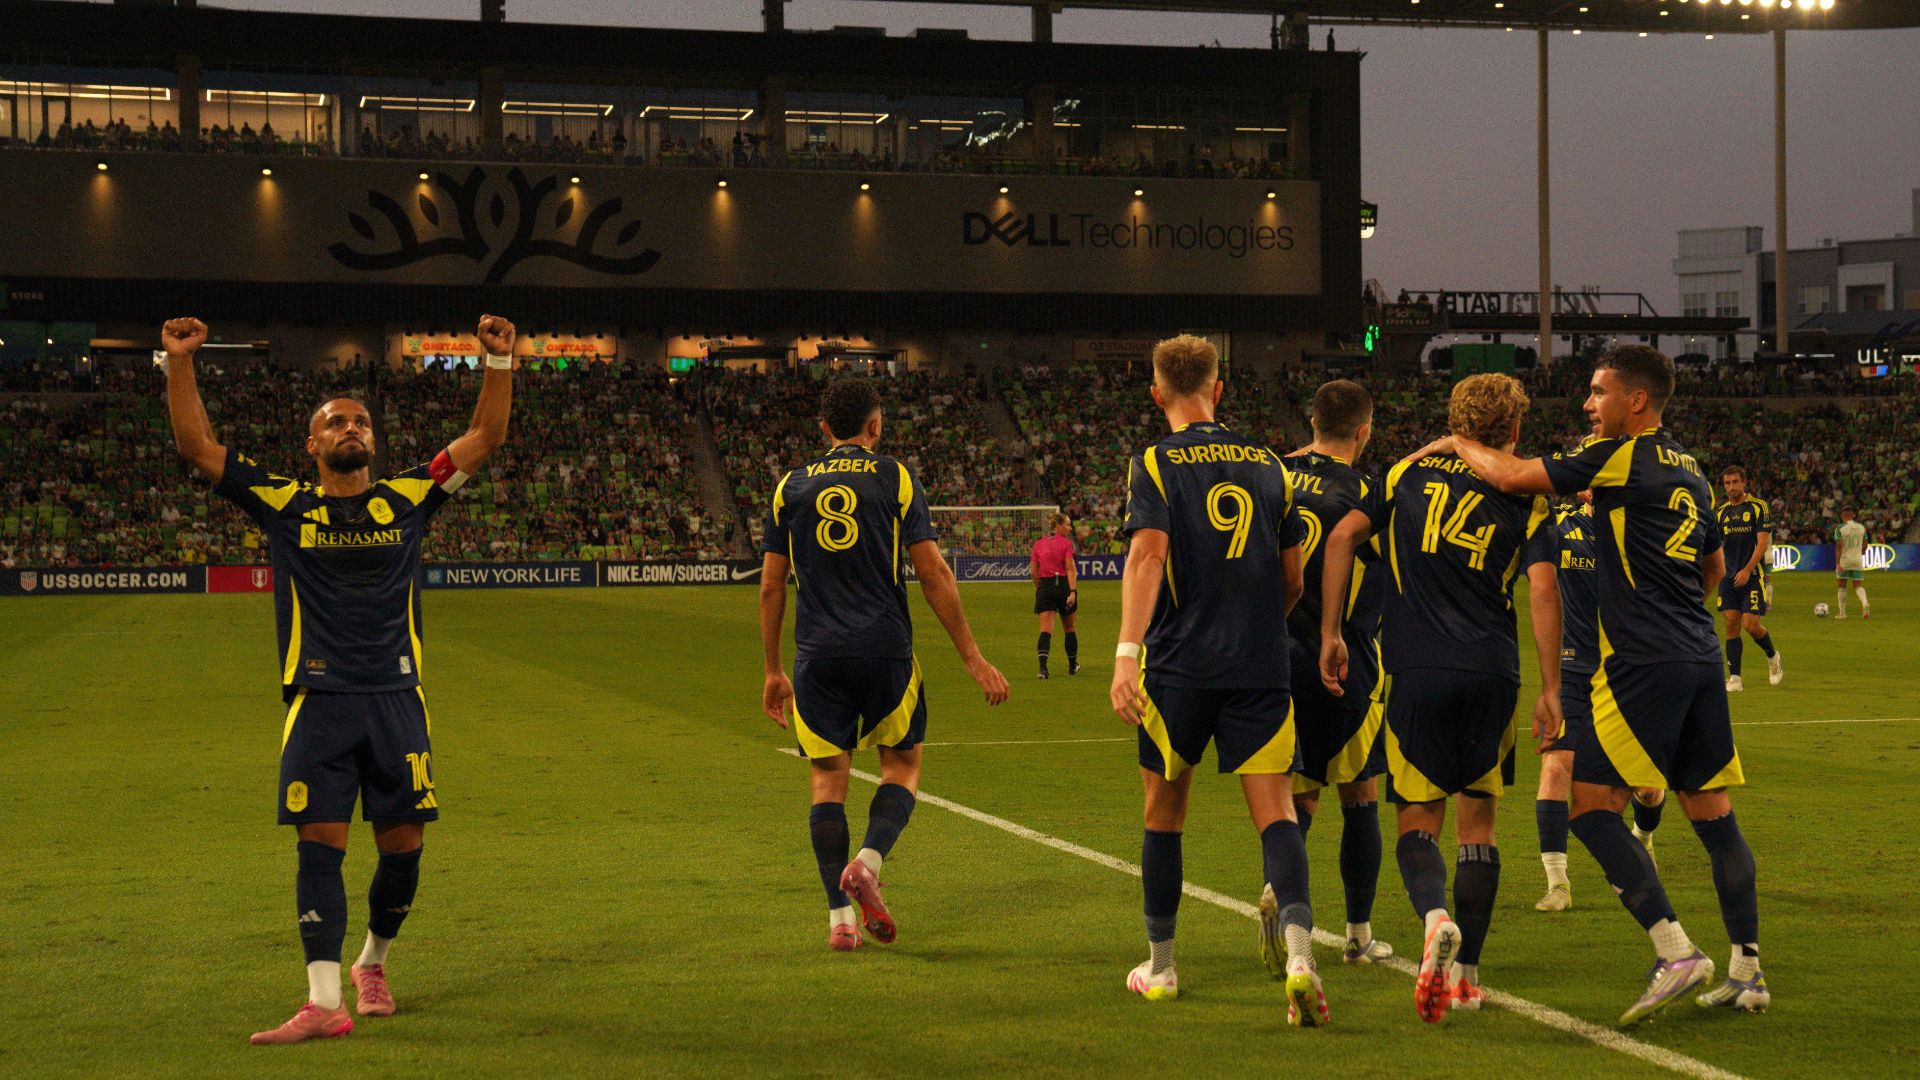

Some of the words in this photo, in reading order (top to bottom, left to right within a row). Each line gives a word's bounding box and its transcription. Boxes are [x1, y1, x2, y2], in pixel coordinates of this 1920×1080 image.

[963, 211, 1070, 247] DELL
[1071, 213, 1294, 258] Technologies
[1166, 444, 1271, 465] SURRIDGE
[806, 459, 878, 477] YAZBEK
[1289, 471, 1323, 494] UYL
[815, 484, 859, 552] 8
[1206, 482, 1254, 560] 9
[1421, 482, 1497, 571] 14
[1665, 487, 1699, 562] 2
[318, 529, 402, 545] RENASANT
[1077, 560, 1119, 576] TRA
[1571, 557, 1596, 569] REN
[42, 572, 187, 589] USSOCCER.COM
[446, 569, 489, 584] NEW
[492, 568, 541, 583] YORK
[544, 567, 580, 582] LIFE
[607, 564, 728, 583] NIKE.COM/SOCCER
[1750, 590, 1759, 604] 5
[405, 751, 435, 792] 10
